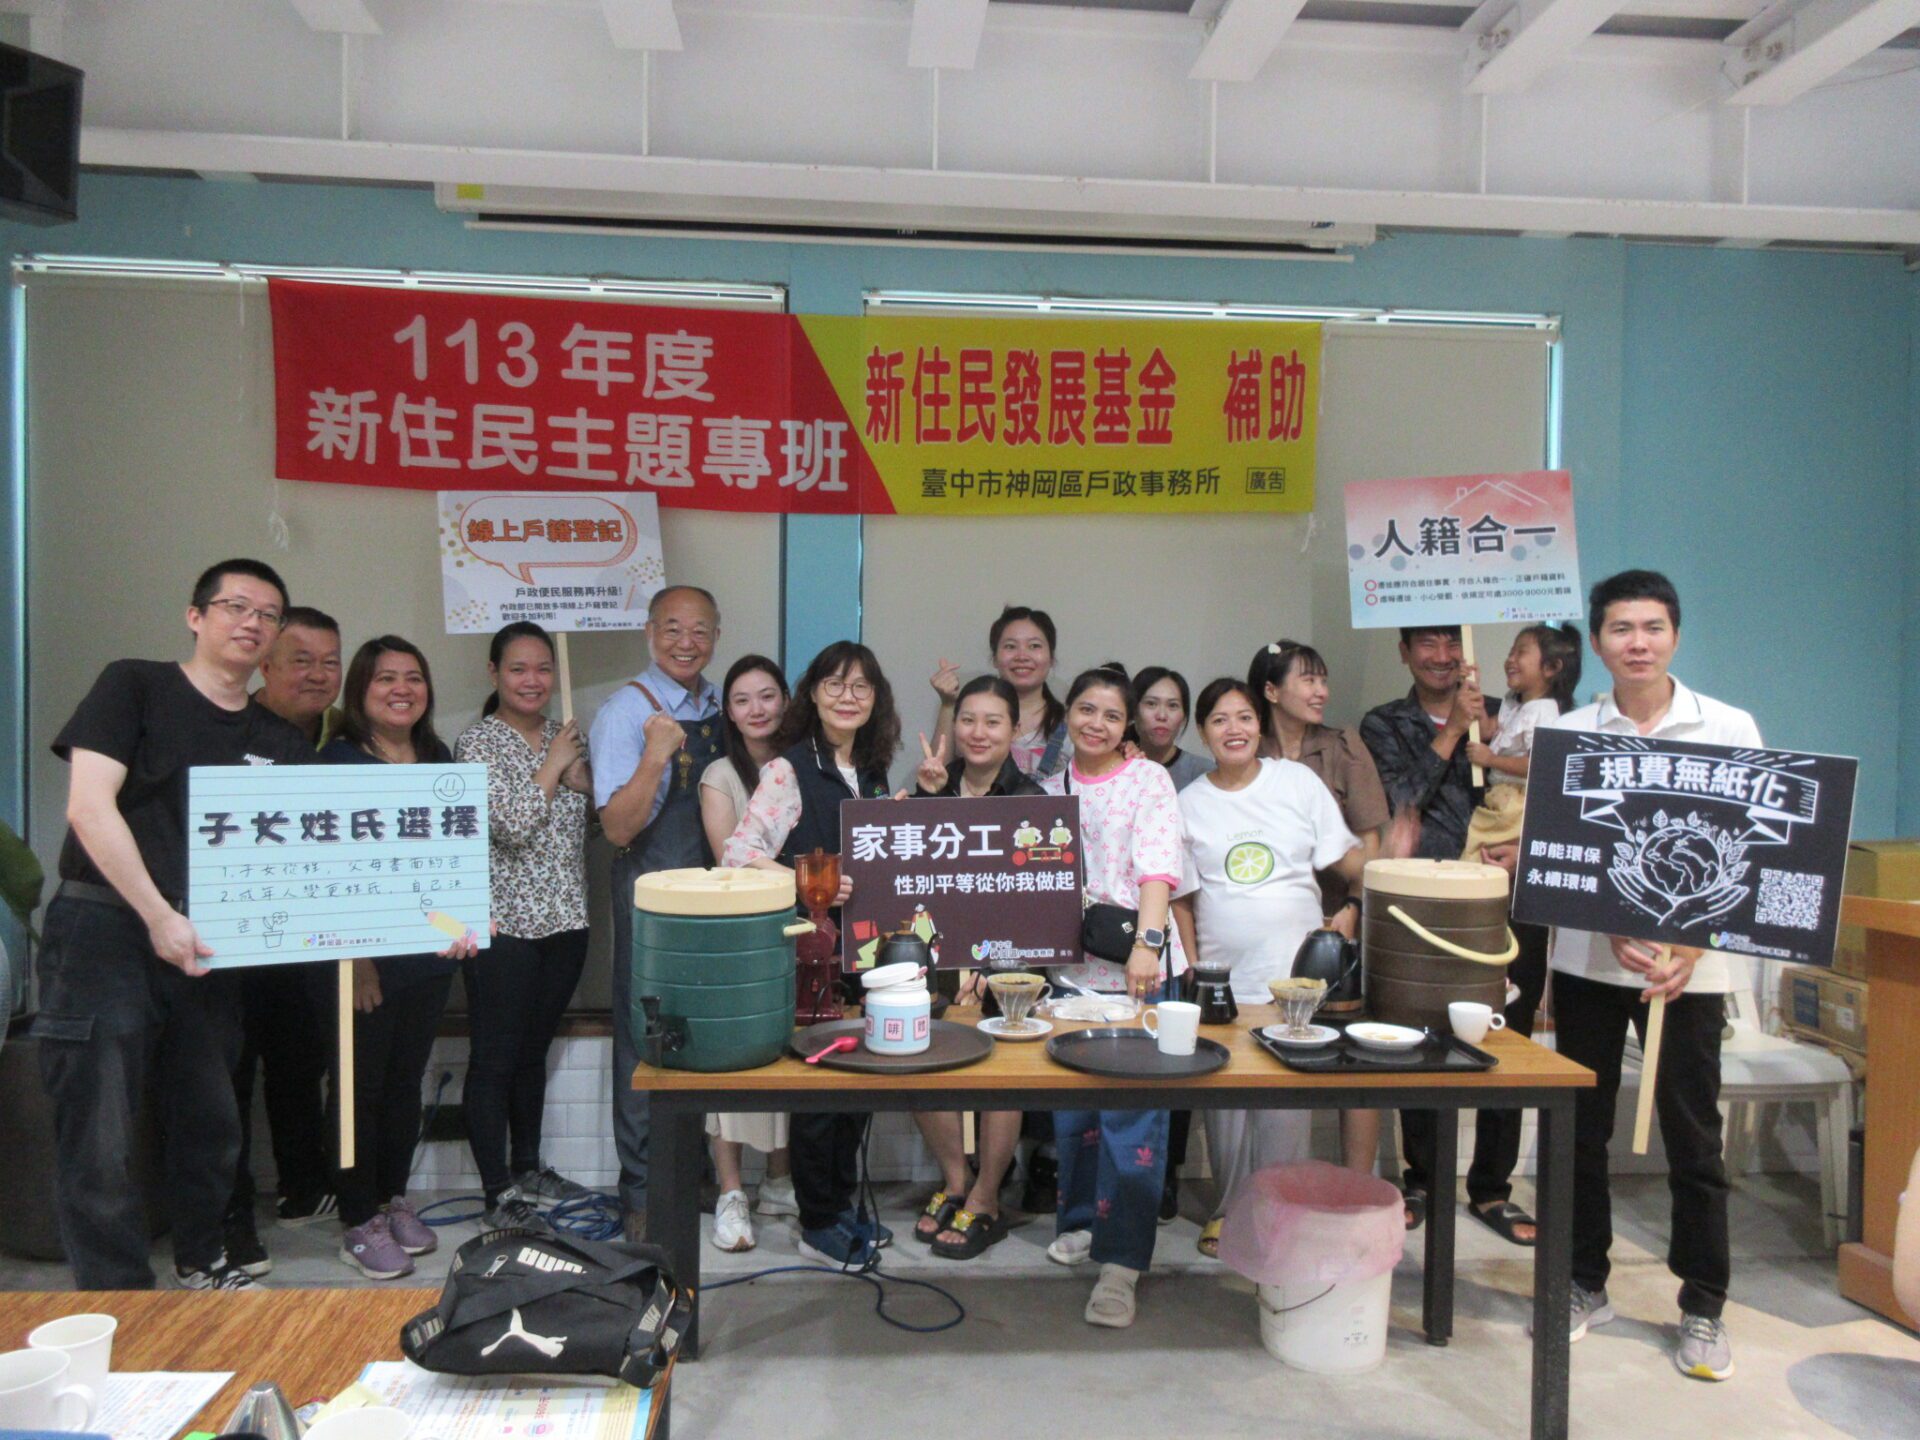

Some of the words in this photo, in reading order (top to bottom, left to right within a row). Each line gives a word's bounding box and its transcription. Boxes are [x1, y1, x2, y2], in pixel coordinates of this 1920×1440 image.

[394, 315, 716, 402] 113年度
[865, 345, 1178, 447] 新住民發展基金
[1222, 348, 1307, 445] 補助
[306, 387, 849, 492] 新住民主題專班
[1247, 467, 1285, 493] 廣告
[466, 519, 624, 543] 線上戶籍登記
[1374, 514, 1557, 558] 人籍合一
[1599, 754, 1789, 809] 規費無紙化
[199, 805, 480, 846] 子女姓氏選擇
[851, 822, 1004, 862] 家事分工
[1226, 829, 1263, 841] Lemon
[1530, 840, 1601, 865] 節能環保
[894, 871, 1075, 896] 性別平等從你我做起
[1527, 868, 1598, 894] 永續環境
[517, 1246, 587, 1274] UMA
